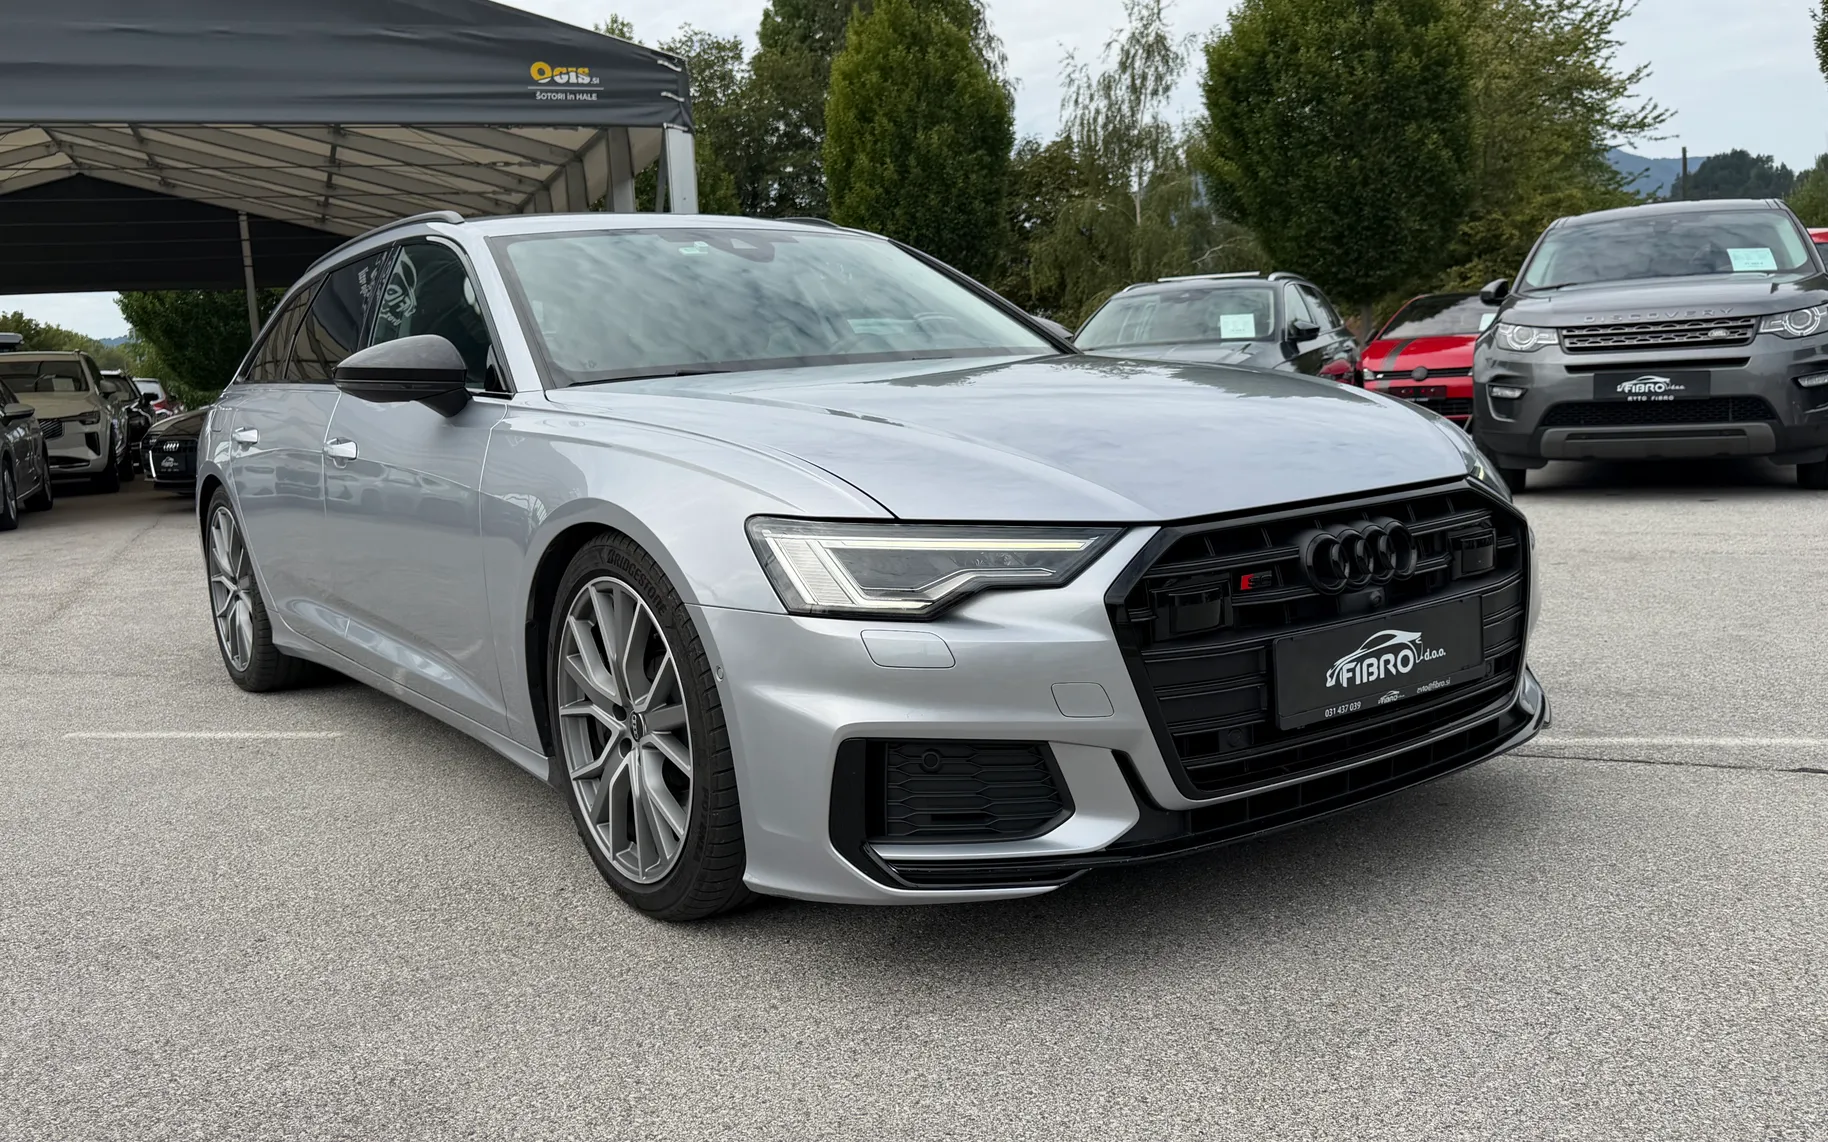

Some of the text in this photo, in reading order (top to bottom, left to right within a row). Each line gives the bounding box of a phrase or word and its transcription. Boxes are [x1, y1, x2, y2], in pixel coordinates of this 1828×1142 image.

[536, 91, 598, 101] ŠOTORI in HALE
[1584, 308, 1734, 323] DISCOVERY
[1623, 382, 1666, 393] FIBRO
[1339, 648, 1447, 688] FIBRO d.o.o.
[1324, 701, 1362, 718] 031 437 039
